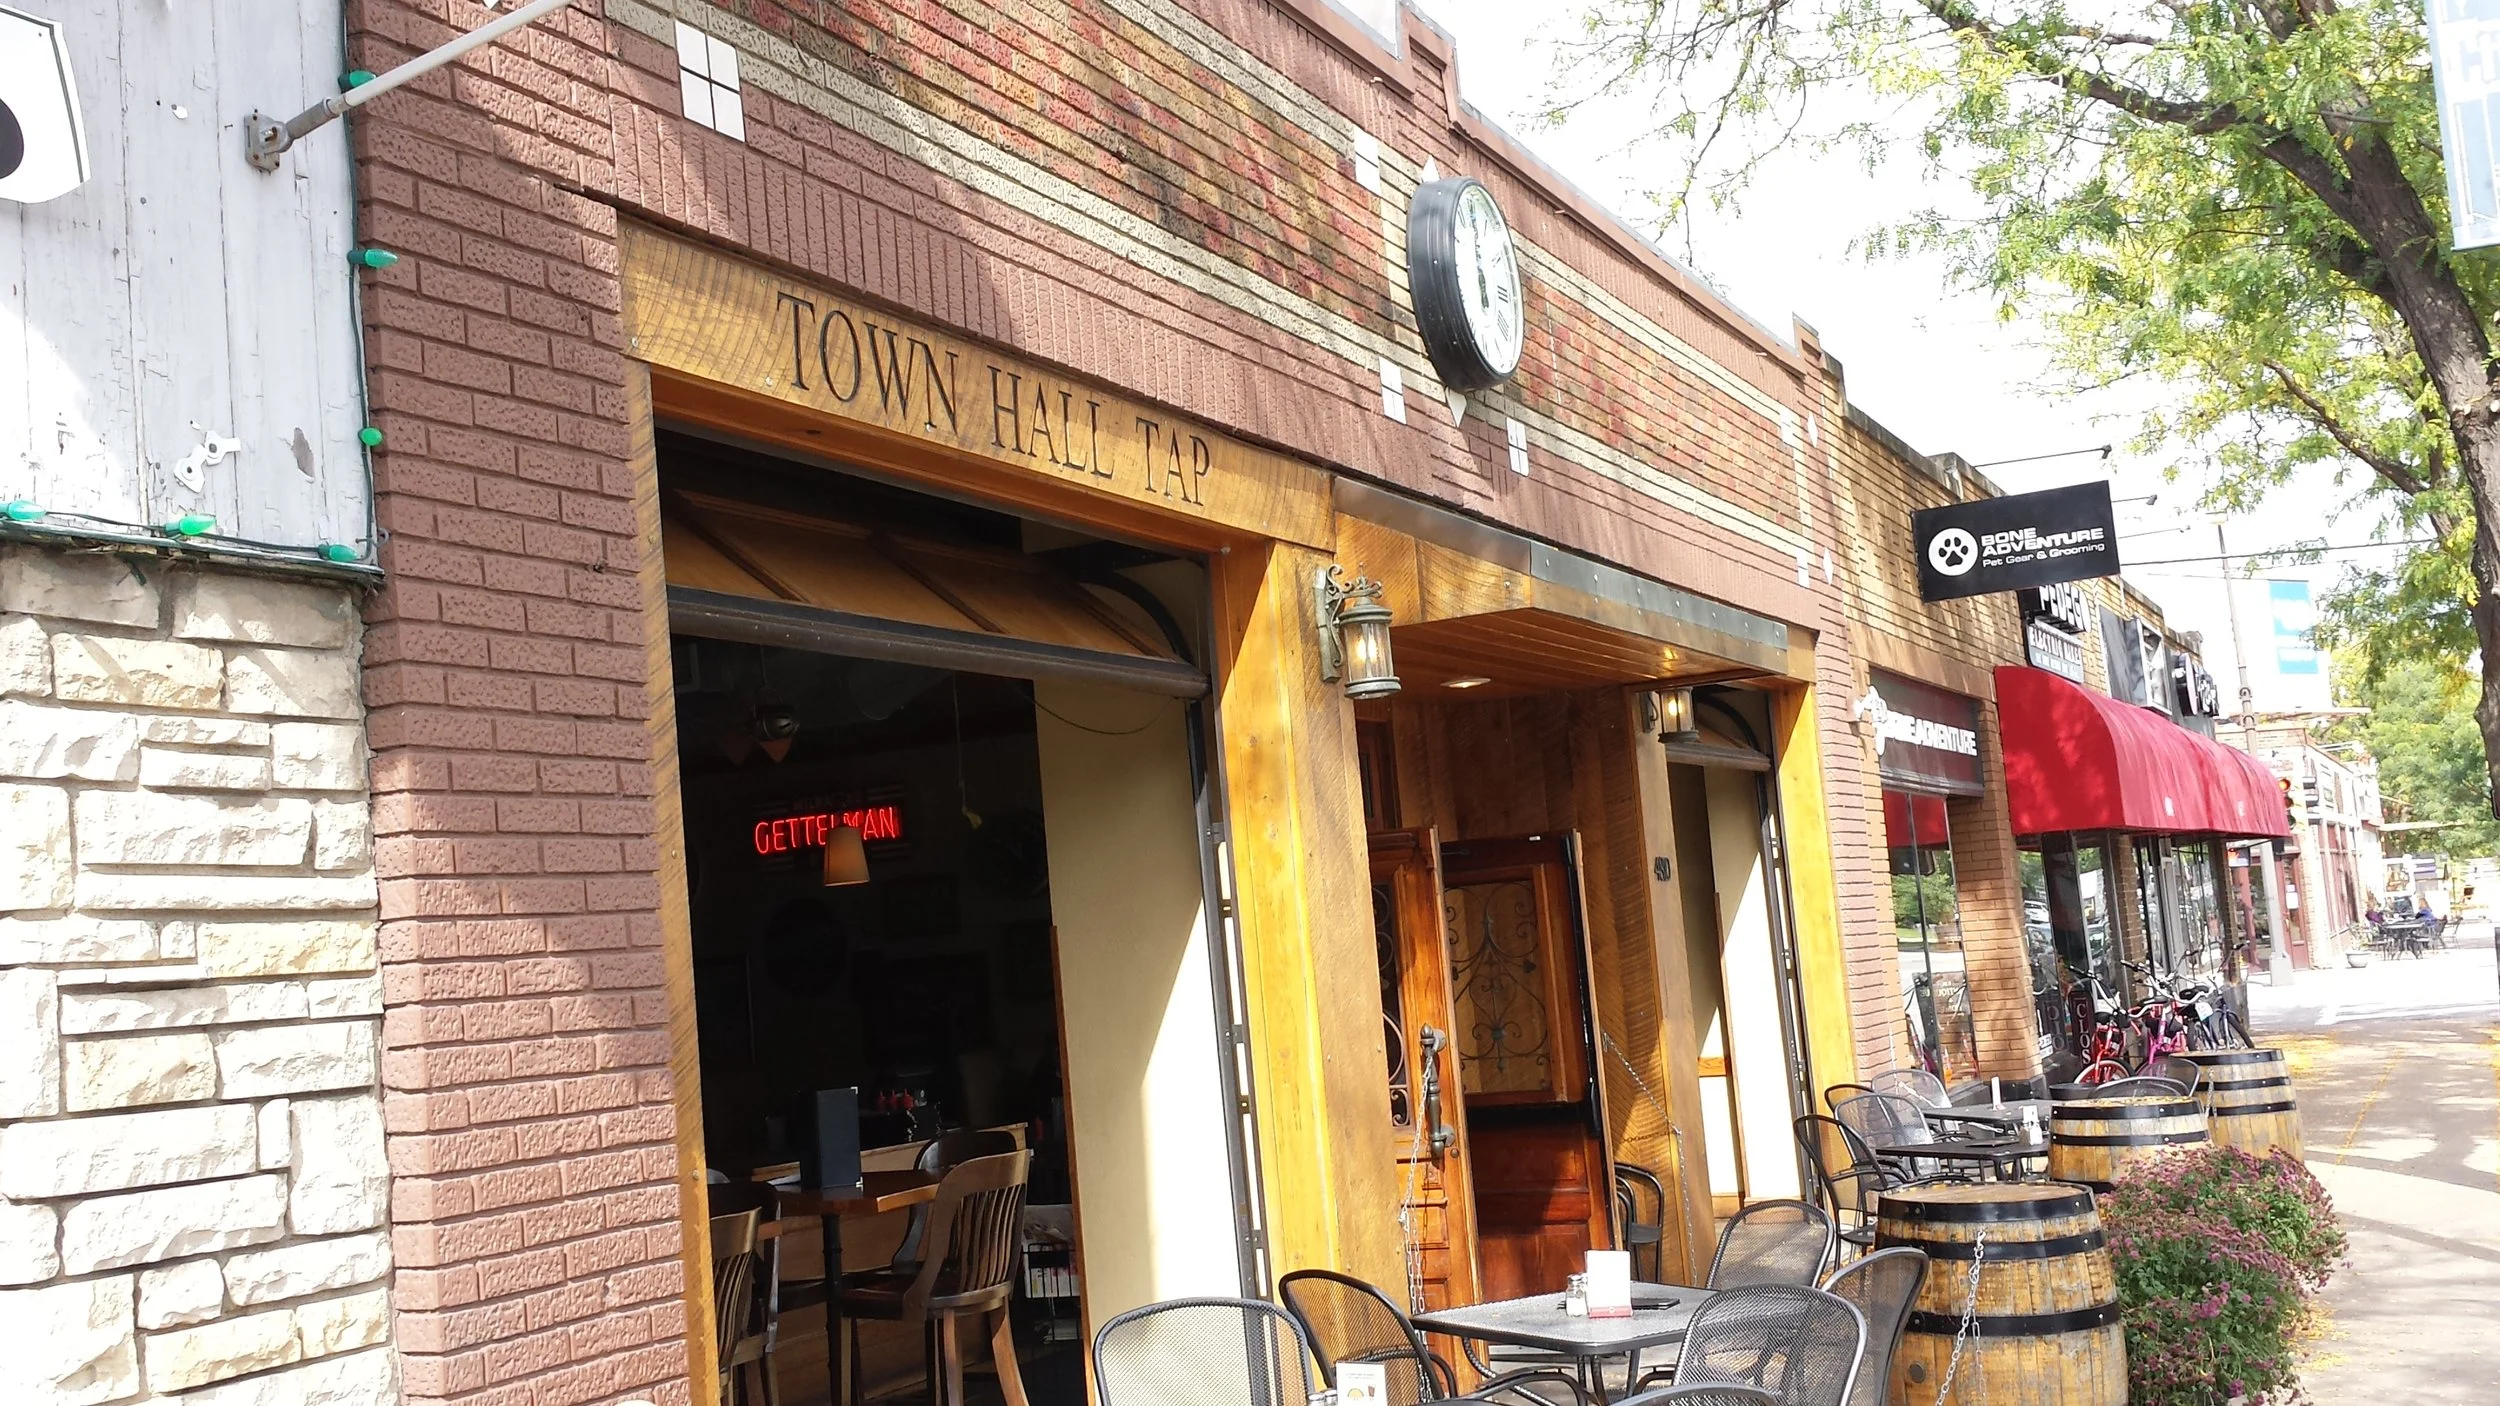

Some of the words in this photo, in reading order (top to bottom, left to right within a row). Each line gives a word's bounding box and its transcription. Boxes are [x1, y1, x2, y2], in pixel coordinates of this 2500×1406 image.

[776, 291, 959, 437] TOWN
[985, 364, 1115, 480] HALL
[1135, 416, 1211, 507] TAP
[1981, 527, 2037, 547] BONE
[1982, 527, 2105, 557] ADVENTURE
[1982, 558, 2004, 568] Pet
[2005, 552, 2034, 564] Gear
[2036, 550, 2048, 560] &
[2048, 543, 2105, 558] Grooming
[1915, 718, 1978, 756] ADVENTURE
